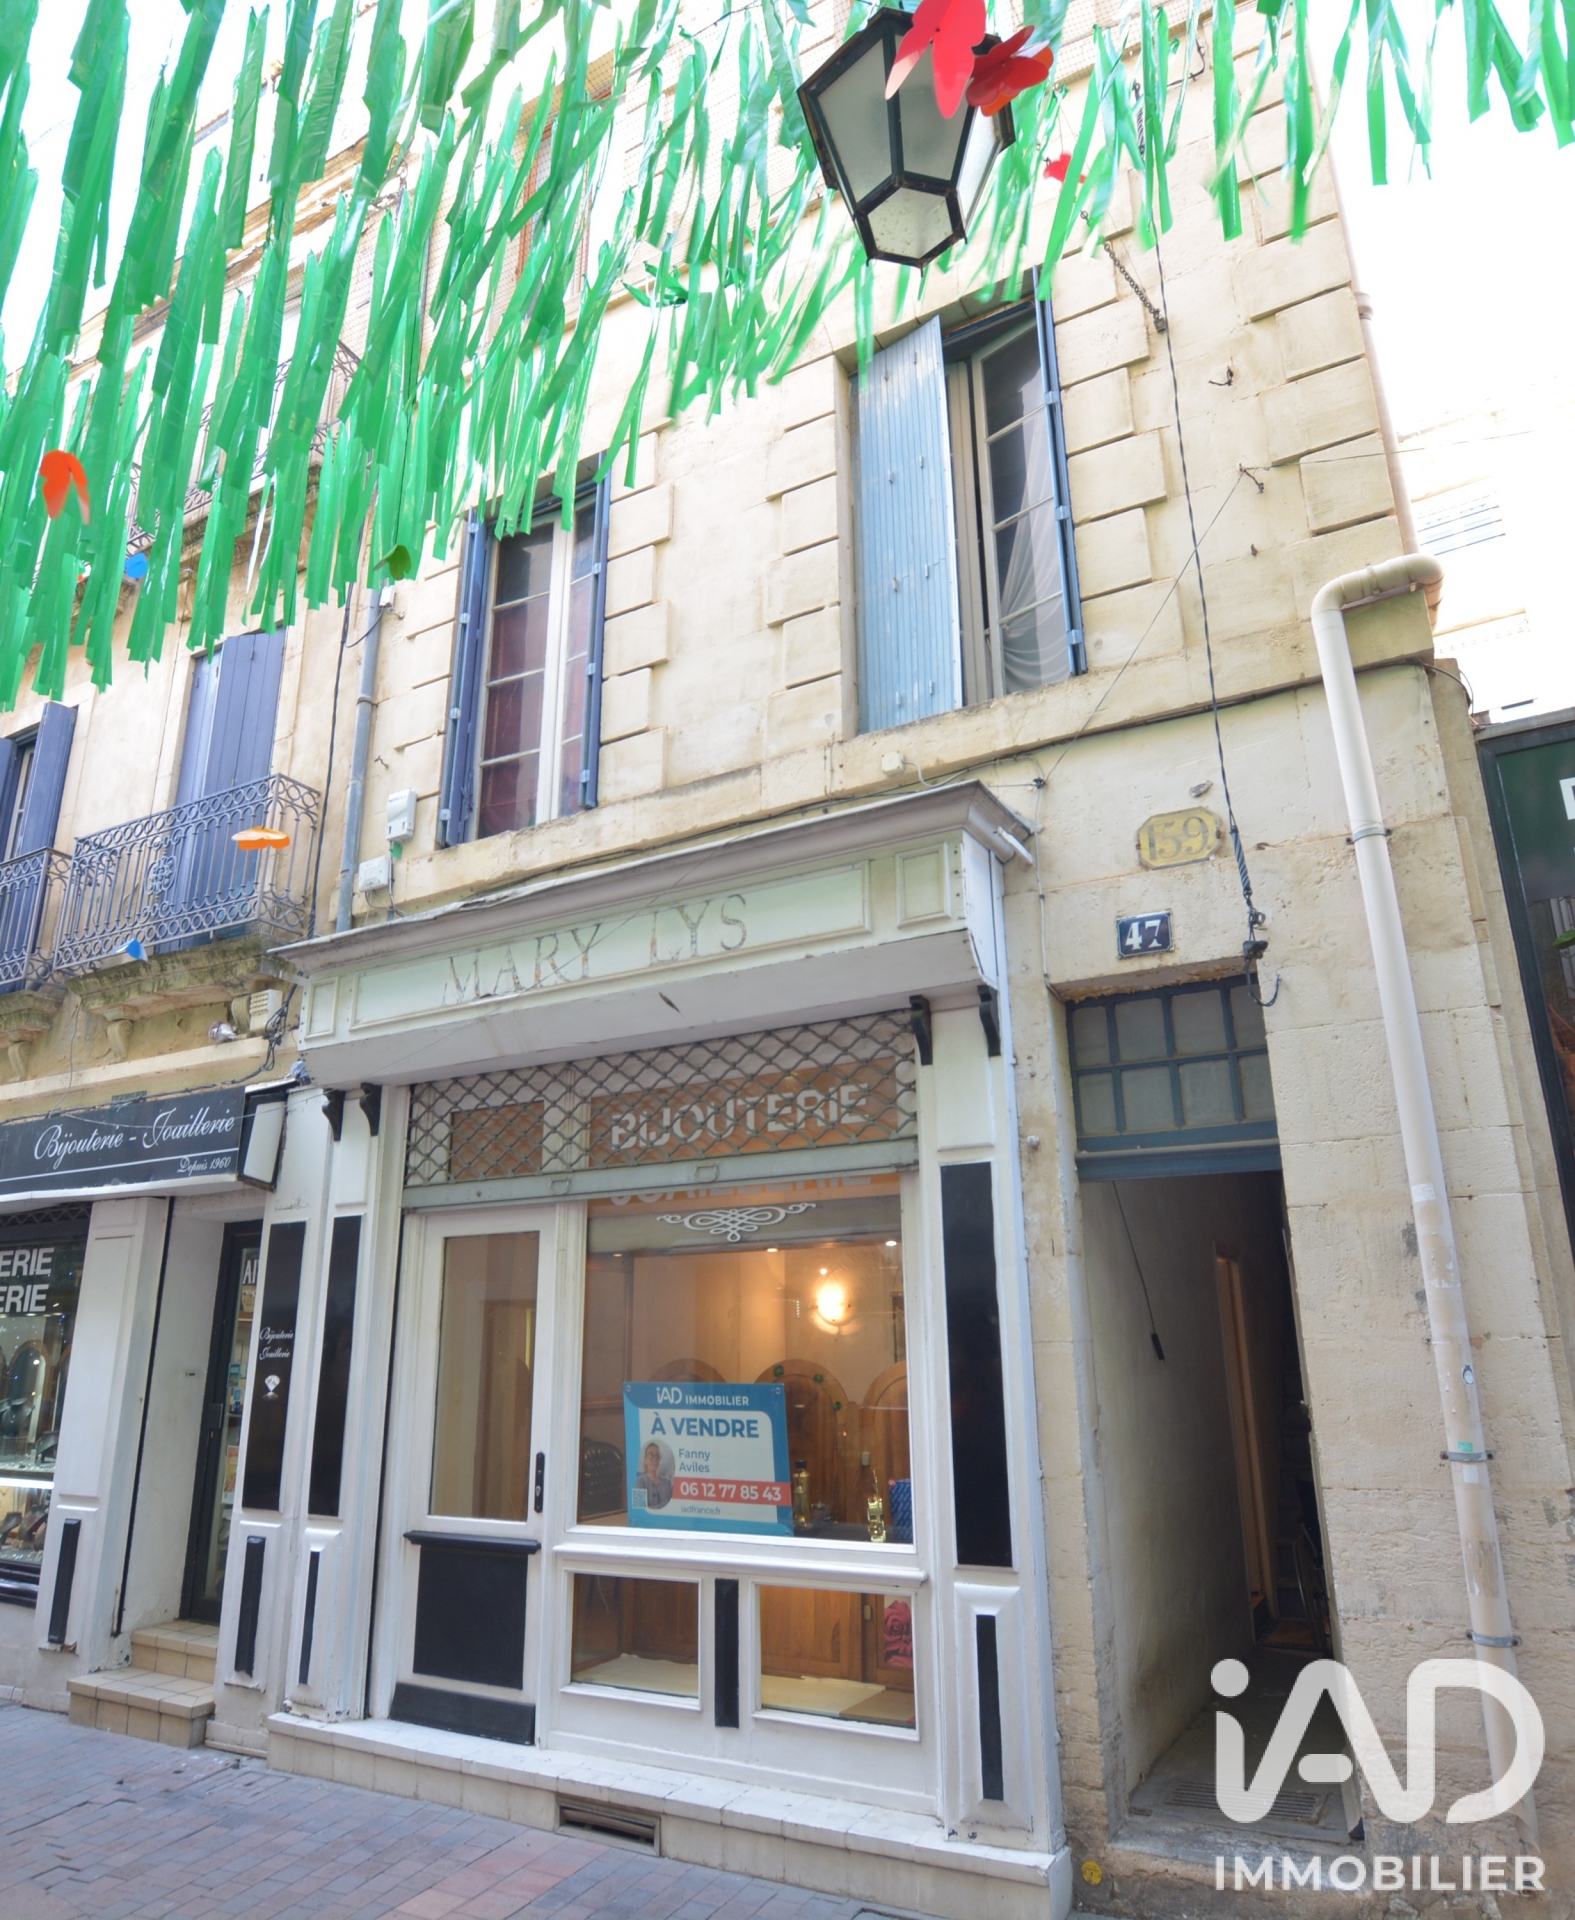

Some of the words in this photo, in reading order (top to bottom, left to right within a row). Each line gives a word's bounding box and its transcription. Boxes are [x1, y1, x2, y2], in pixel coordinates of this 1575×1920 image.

[1125, 919, 1163, 951] 47
[441, 922, 602, 1006] MARY
[611, 1083, 870, 1151] BIJOUTERIE
[33, 1124, 124, 1170] Bijouterie
[142, 1106, 235, 1149] Joaillerie
[177, 1156, 208, 1176] Depuis
[209, 1156, 232, 1170] 1960
[260, 1327, 294, 1344] Bijouterie
[685, 1395, 749, 1406] IMMOBILIER
[651, 1412, 666, 1435] À
[670, 1417, 760, 1438] VENDRE
[678, 1448, 711, 1462] Fanny
[678, 1462, 710, 1473] Aviles
[680, 1481, 699, 1496] 06
[701, 1483, 716, 1498] 12
[719, 1484, 737, 1499] 77
[740, 1485, 759, 1500] 85
[762, 1487, 782, 1502] 43
[680, 1505, 722, 1516] iadfrance.fr
